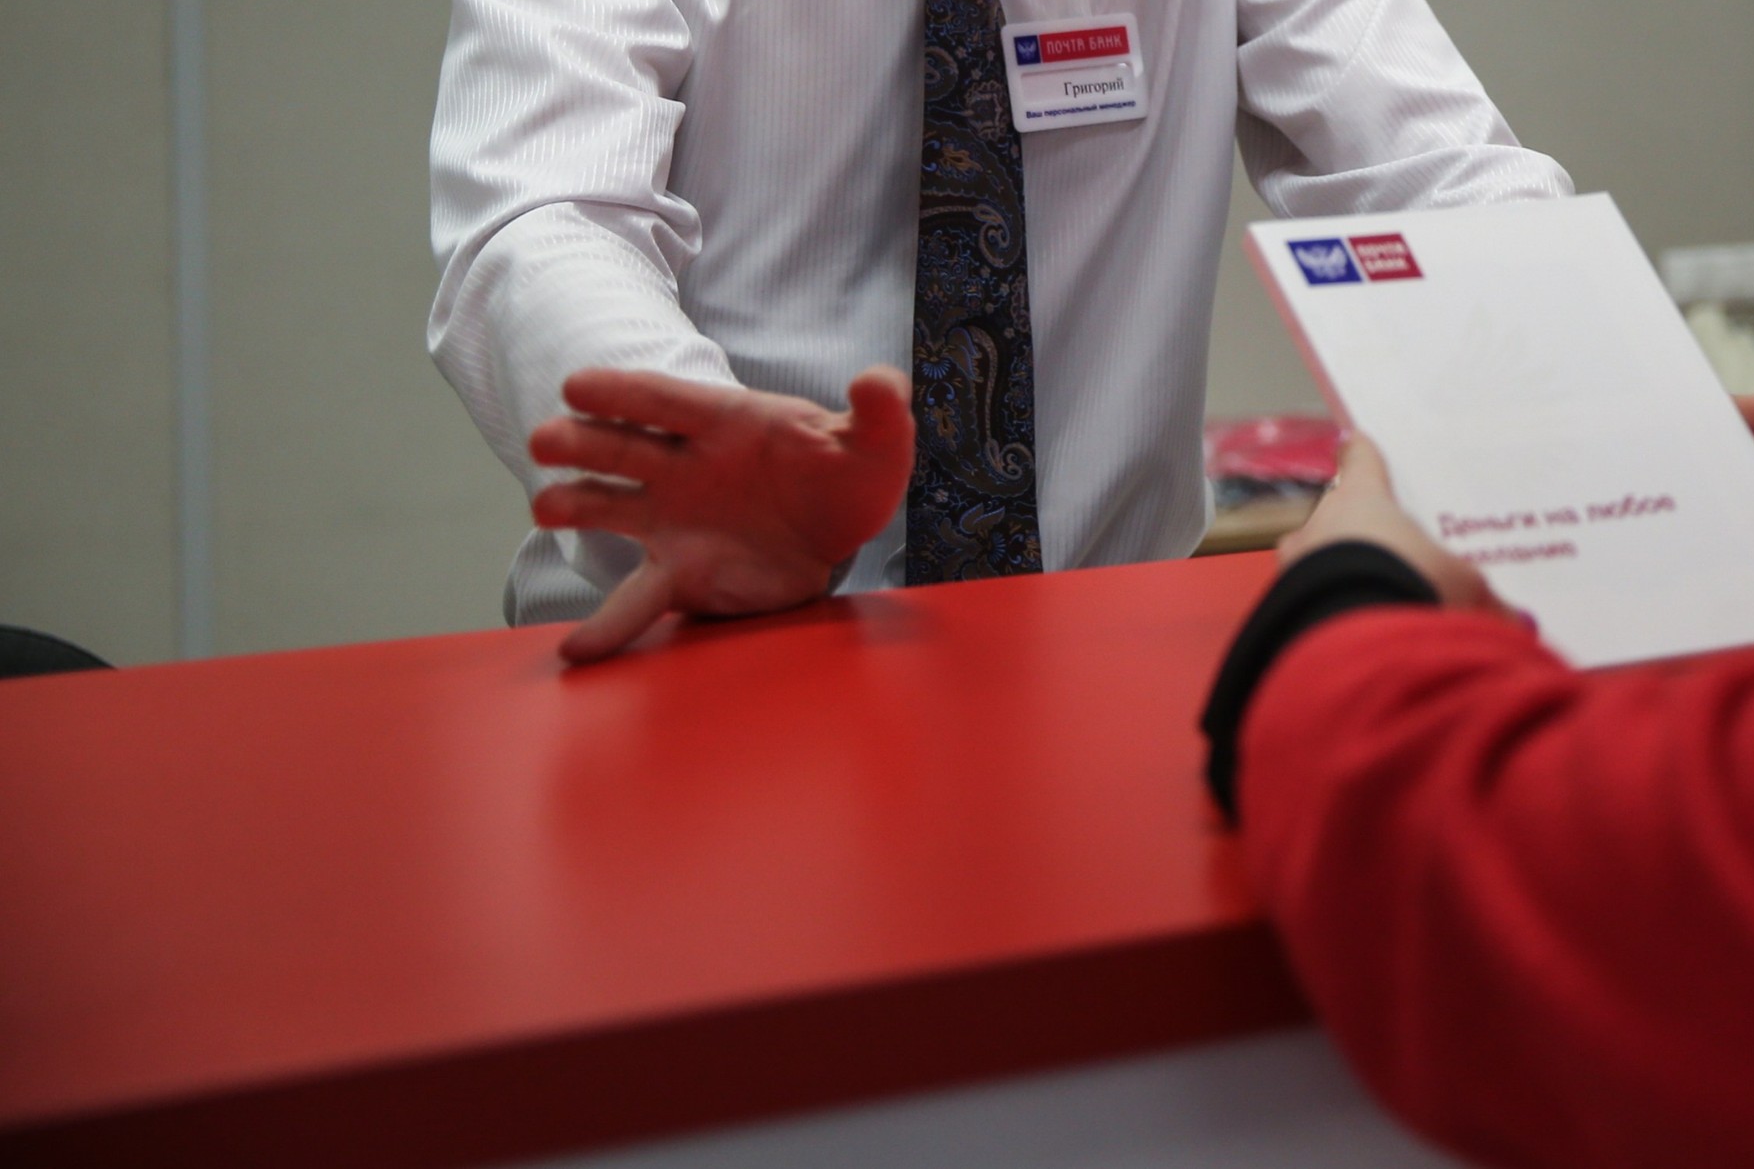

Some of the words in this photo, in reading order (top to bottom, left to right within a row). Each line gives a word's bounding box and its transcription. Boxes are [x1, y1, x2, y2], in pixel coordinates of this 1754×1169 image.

[1046, 37, 1085, 55] ПОЧТА
[1089, 34, 1123, 51] БАНК
[1063, 77, 1125, 99] Григорий
[1026, 110, 1043, 119] Ваш
[1044, 104, 1098, 118] персональный
[1098, 100, 1137, 110] менеджер
[1438, 511, 1537, 538] Деньги
[1544, 506, 1581, 525] на
[1585, 493, 1677, 523] любое
